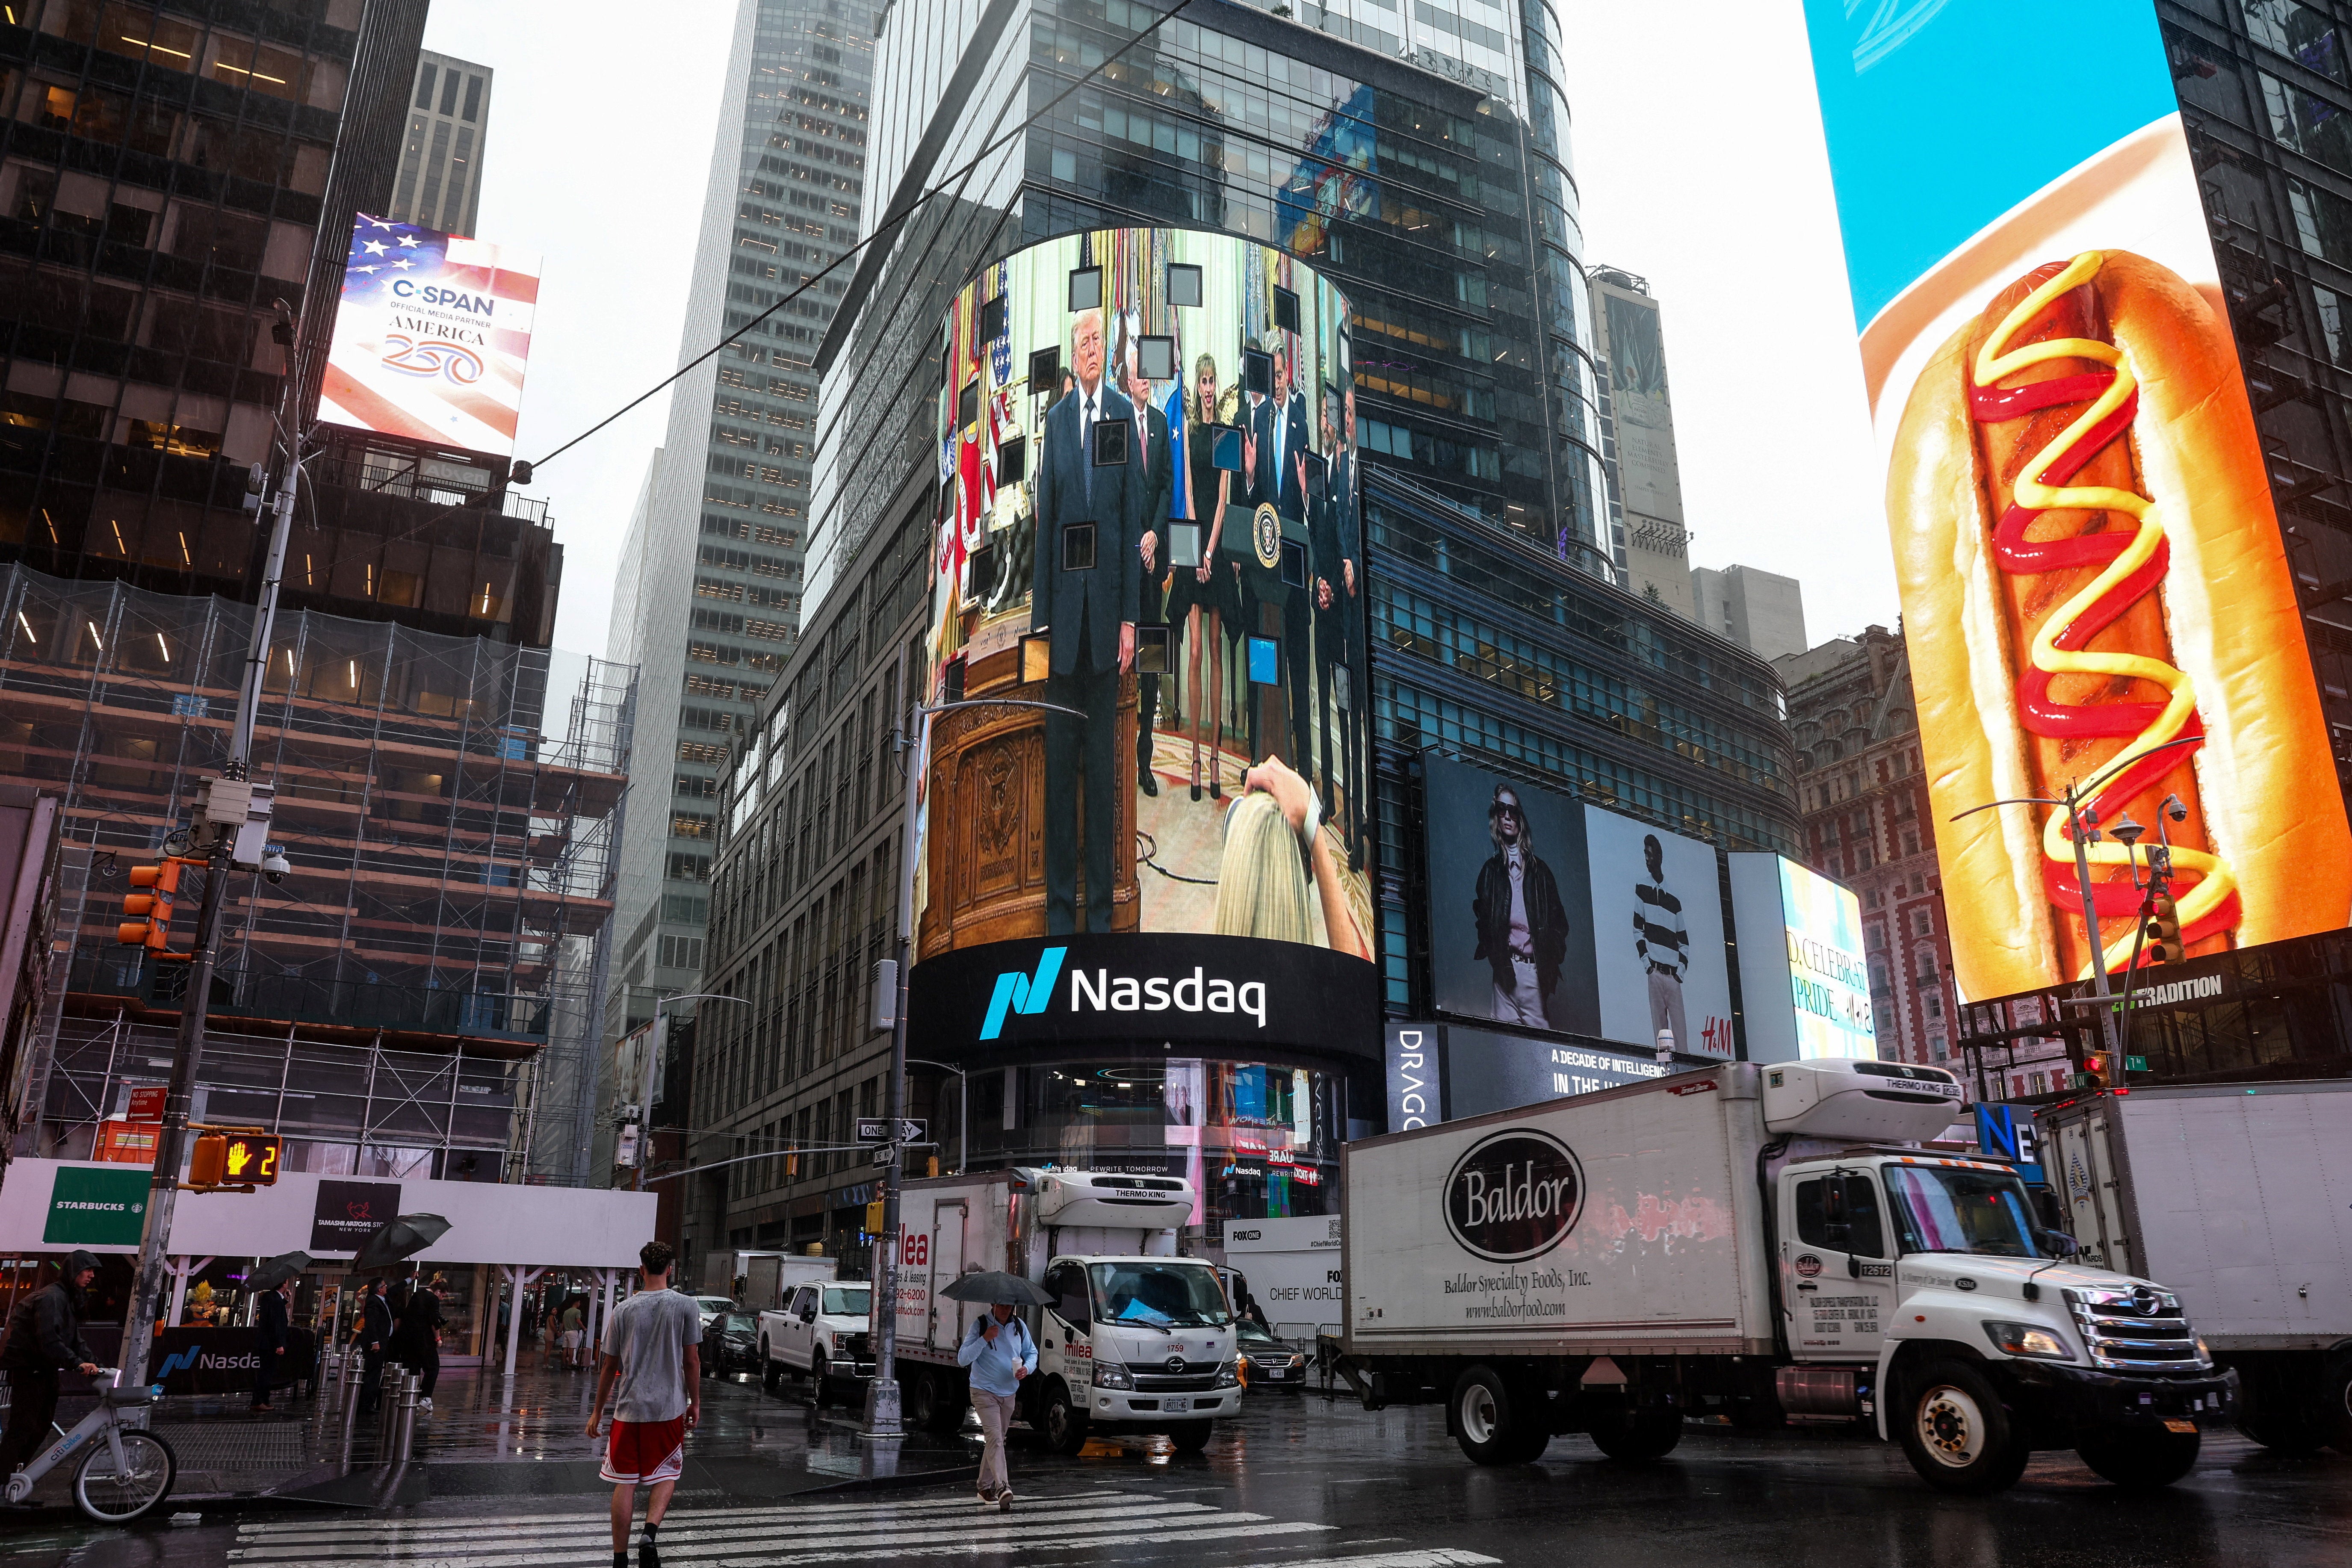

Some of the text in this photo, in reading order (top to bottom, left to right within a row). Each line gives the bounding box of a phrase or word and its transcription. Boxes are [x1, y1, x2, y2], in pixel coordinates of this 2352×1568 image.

[390, 301, 491, 328] OFFICIAL MEDIA PARTNER
[389, 315, 485, 345] AMERICA
[381, 334, 484, 386] 250
[1632, 437, 1661, 450] NATURAL
[1632, 444, 1662, 458] ELEMENTS
[1628, 451, 1669, 467] MASTERFULLY
[1631, 459, 1666, 474] COMBINED
[265, 845, 283, 853] NYPD
[1072, 966, 1266, 1028] Nasdaq
[1795, 976, 1837, 1021] PRIDE
[2136, 974, 2222, 1008] TRADITION
[1701, 1015, 1731, 1057] H&M
[1551, 1049, 1559, 1062] A
[1560, 1050, 1597, 1069] DECADE
[1599, 1057, 1610, 1070] OF
[2130, 1057, 2135, 1068] 7
[1554, 1072, 1569, 1094] IN
[1572, 1075, 1600, 1095] THE
[1886, 1078, 1921, 1091] THERMO
[1921, 1081, 1941, 1093] KING
[2077, 1075, 2085, 1086] W
[131, 1099, 148, 1107] Anytime
[865, 1126, 883, 1135] ONE
[260, 1147, 275, 1175] 2
[1235, 1167, 1261, 1177] Nasdaq
[1464, 1160, 1569, 1228] Baldor
[56, 1201, 125, 1211] STARBUCKS
[1233, 1231, 1260, 1241] FOX ONE
[879, 1223, 928, 1266] ilea
[904, 1270, 907, 1282] &
[909, 1271, 926, 1286] leasing
[1863, 1265, 1891, 1276] 12612
[1444, 1266, 1591, 1298] Baldor Specialty Foods, Inc.
[1270, 1287, 1342, 1300] CHIEF WORLD
[1466, 1294, 1566, 1323] www.baldorfood.com
[1065, 1340, 1092, 1358] milea
[200, 1352, 260, 1369] Nasda
